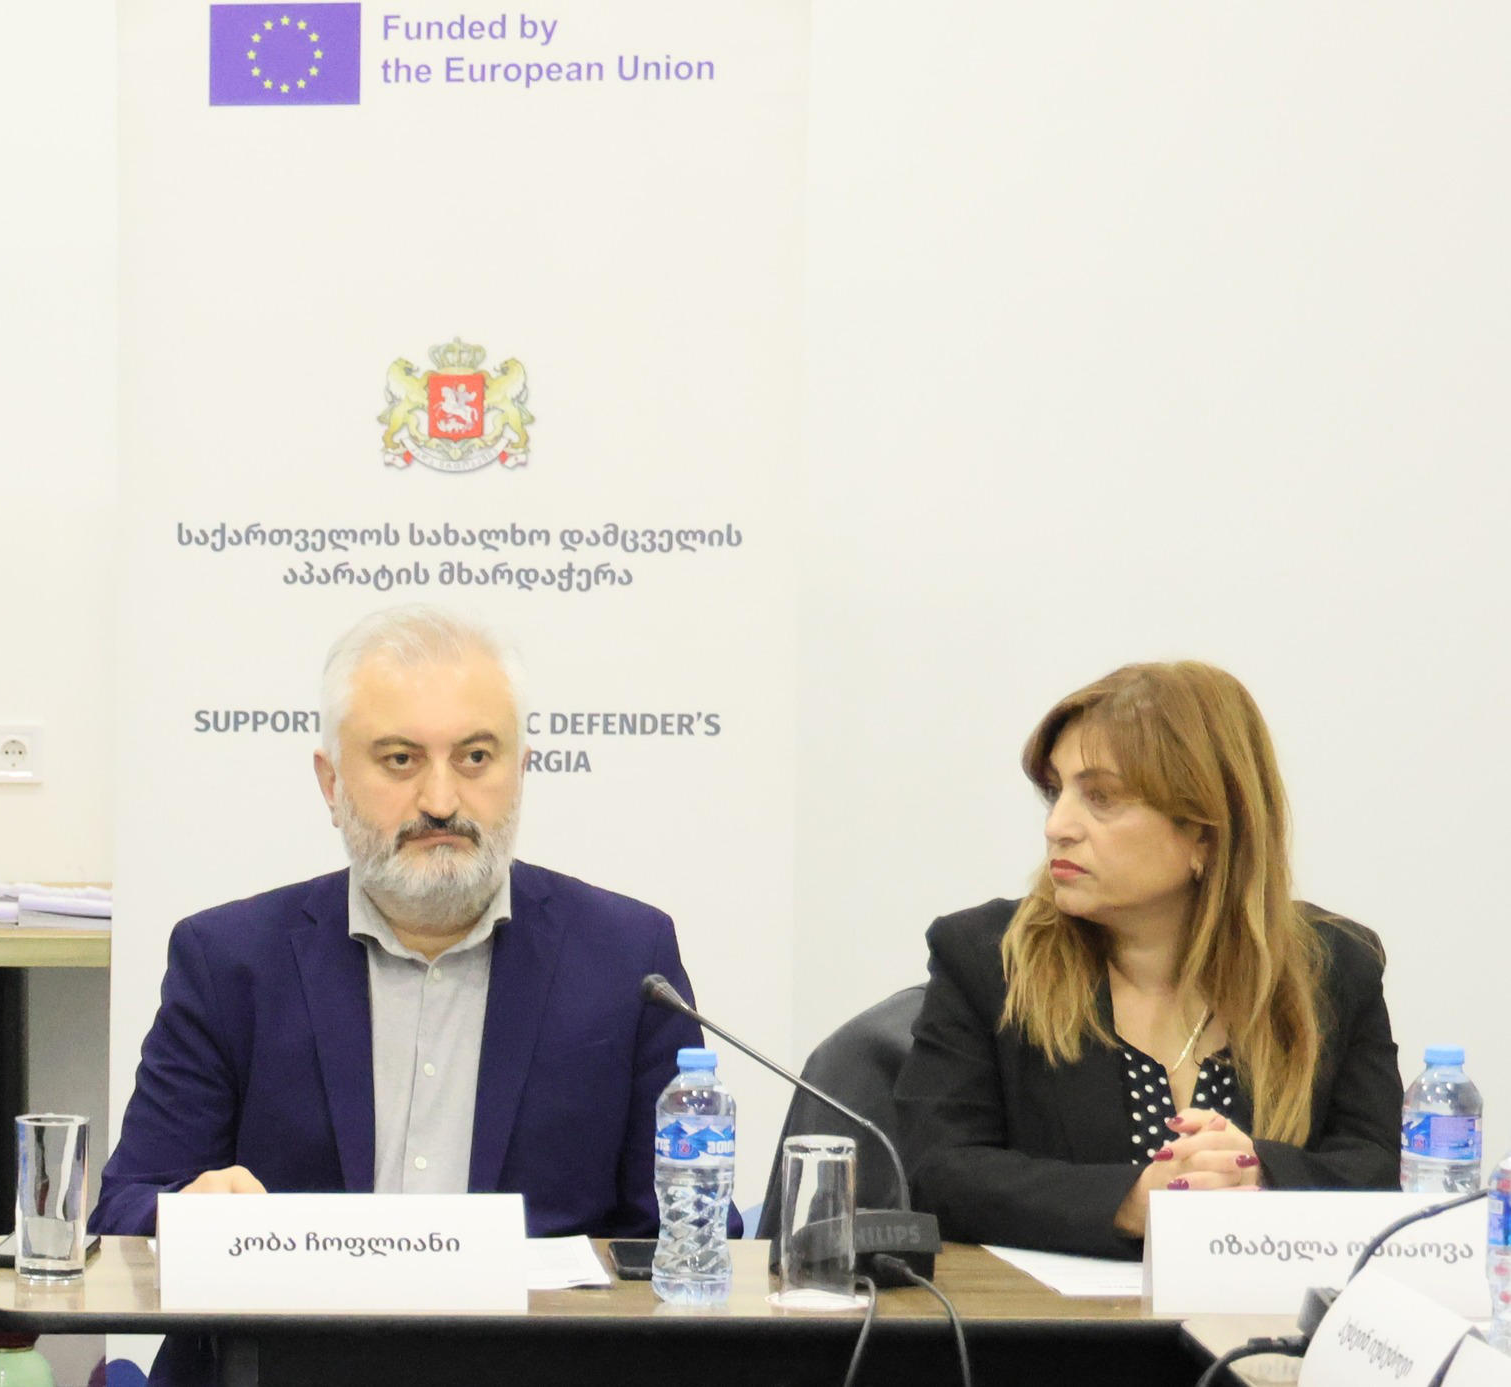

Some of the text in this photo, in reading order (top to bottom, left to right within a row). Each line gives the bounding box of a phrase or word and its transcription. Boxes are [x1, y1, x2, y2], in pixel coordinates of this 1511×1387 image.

[383, 13, 558, 46] Funded by
[381, 55, 715, 89] the European Union
[177, 522, 743, 554] საქართველოს სახალხო დამცველის
[282, 561, 634, 593] აპარატის მხარდაჭერა
[526, 750, 592, 773] RGIA
[228, 1231, 460, 1257] კობა ჩოფლიანი
[1209, 1235, 1337, 1261] იზაბელა
